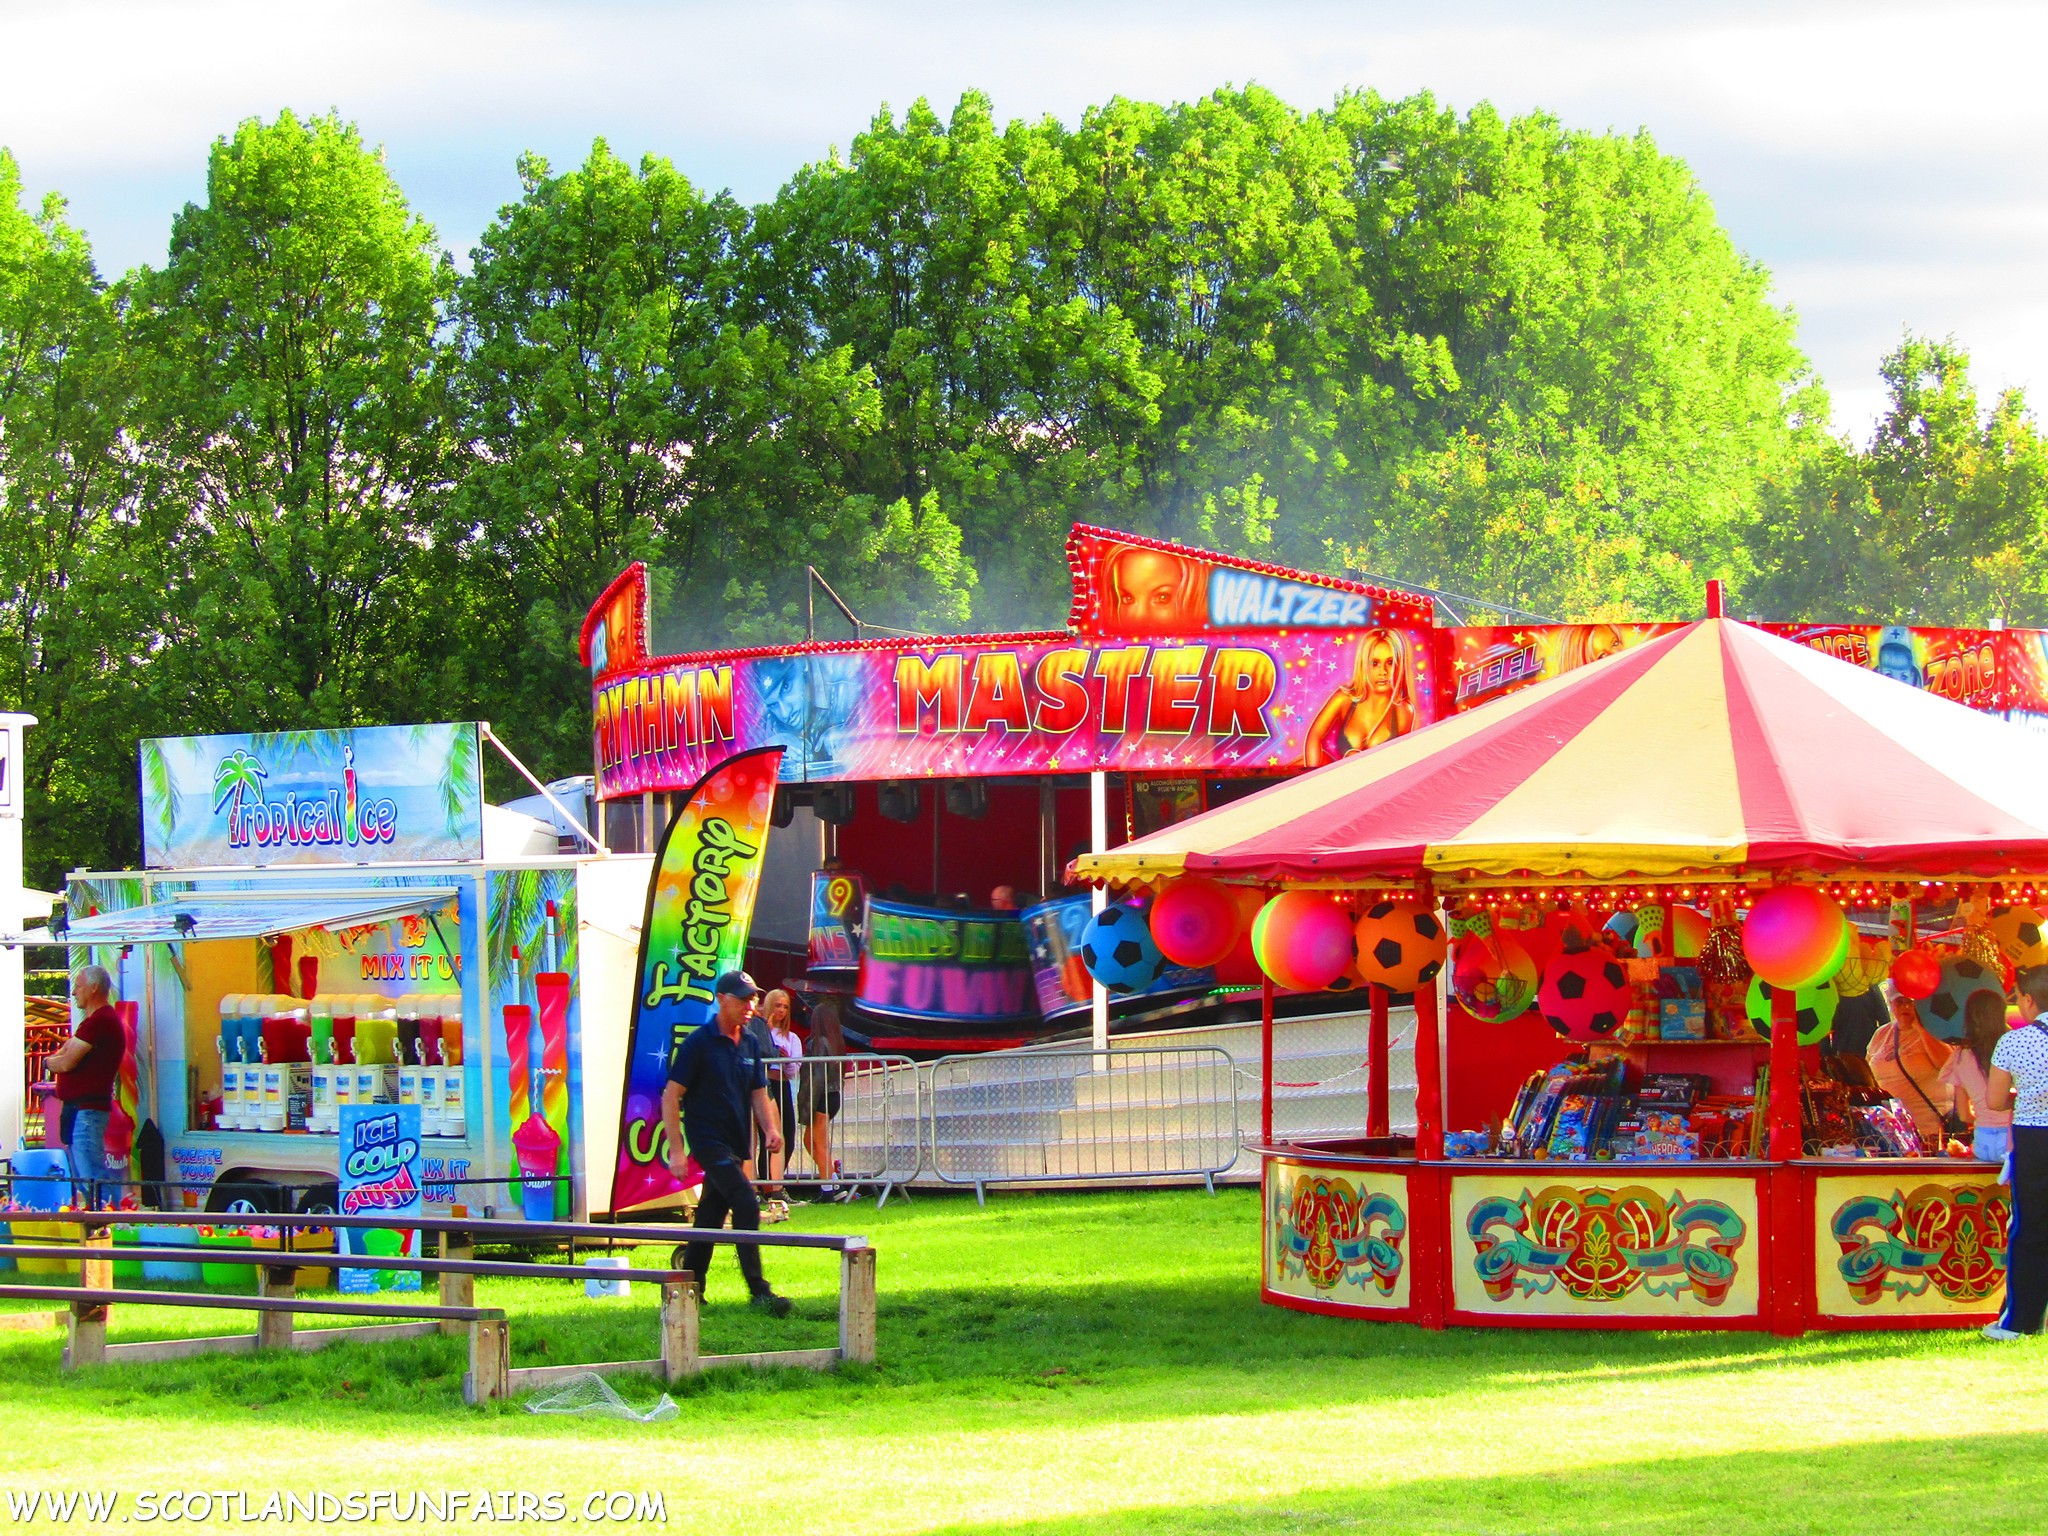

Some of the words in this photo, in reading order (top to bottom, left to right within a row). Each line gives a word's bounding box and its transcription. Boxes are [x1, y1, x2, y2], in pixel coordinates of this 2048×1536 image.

[1212, 573, 1369, 626] WALTZER
[1802, 633, 1868, 665] NCE
[1455, 643, 1544, 701] FEEL
[598, 665, 735, 771] RYTHMN
[893, 645, 1277, 737] MASTER
[1136, 782, 1150, 793] NO
[361, 954, 405, 981] MIX
[409, 954, 433, 981] IT
[355, 1114, 398, 1148] ICE
[105, 1153, 128, 1170] Slush
[172, 1147, 222, 1164] CREATE
[348, 1140, 417, 1176] COLD
[421, 1157, 445, 1180] IX
[448, 1157, 470, 1180] IT
[180, 1165, 215, 1180] YOUR
[344, 1163, 417, 1216] SLUSH
[421, 1183, 456, 1203] UP!
